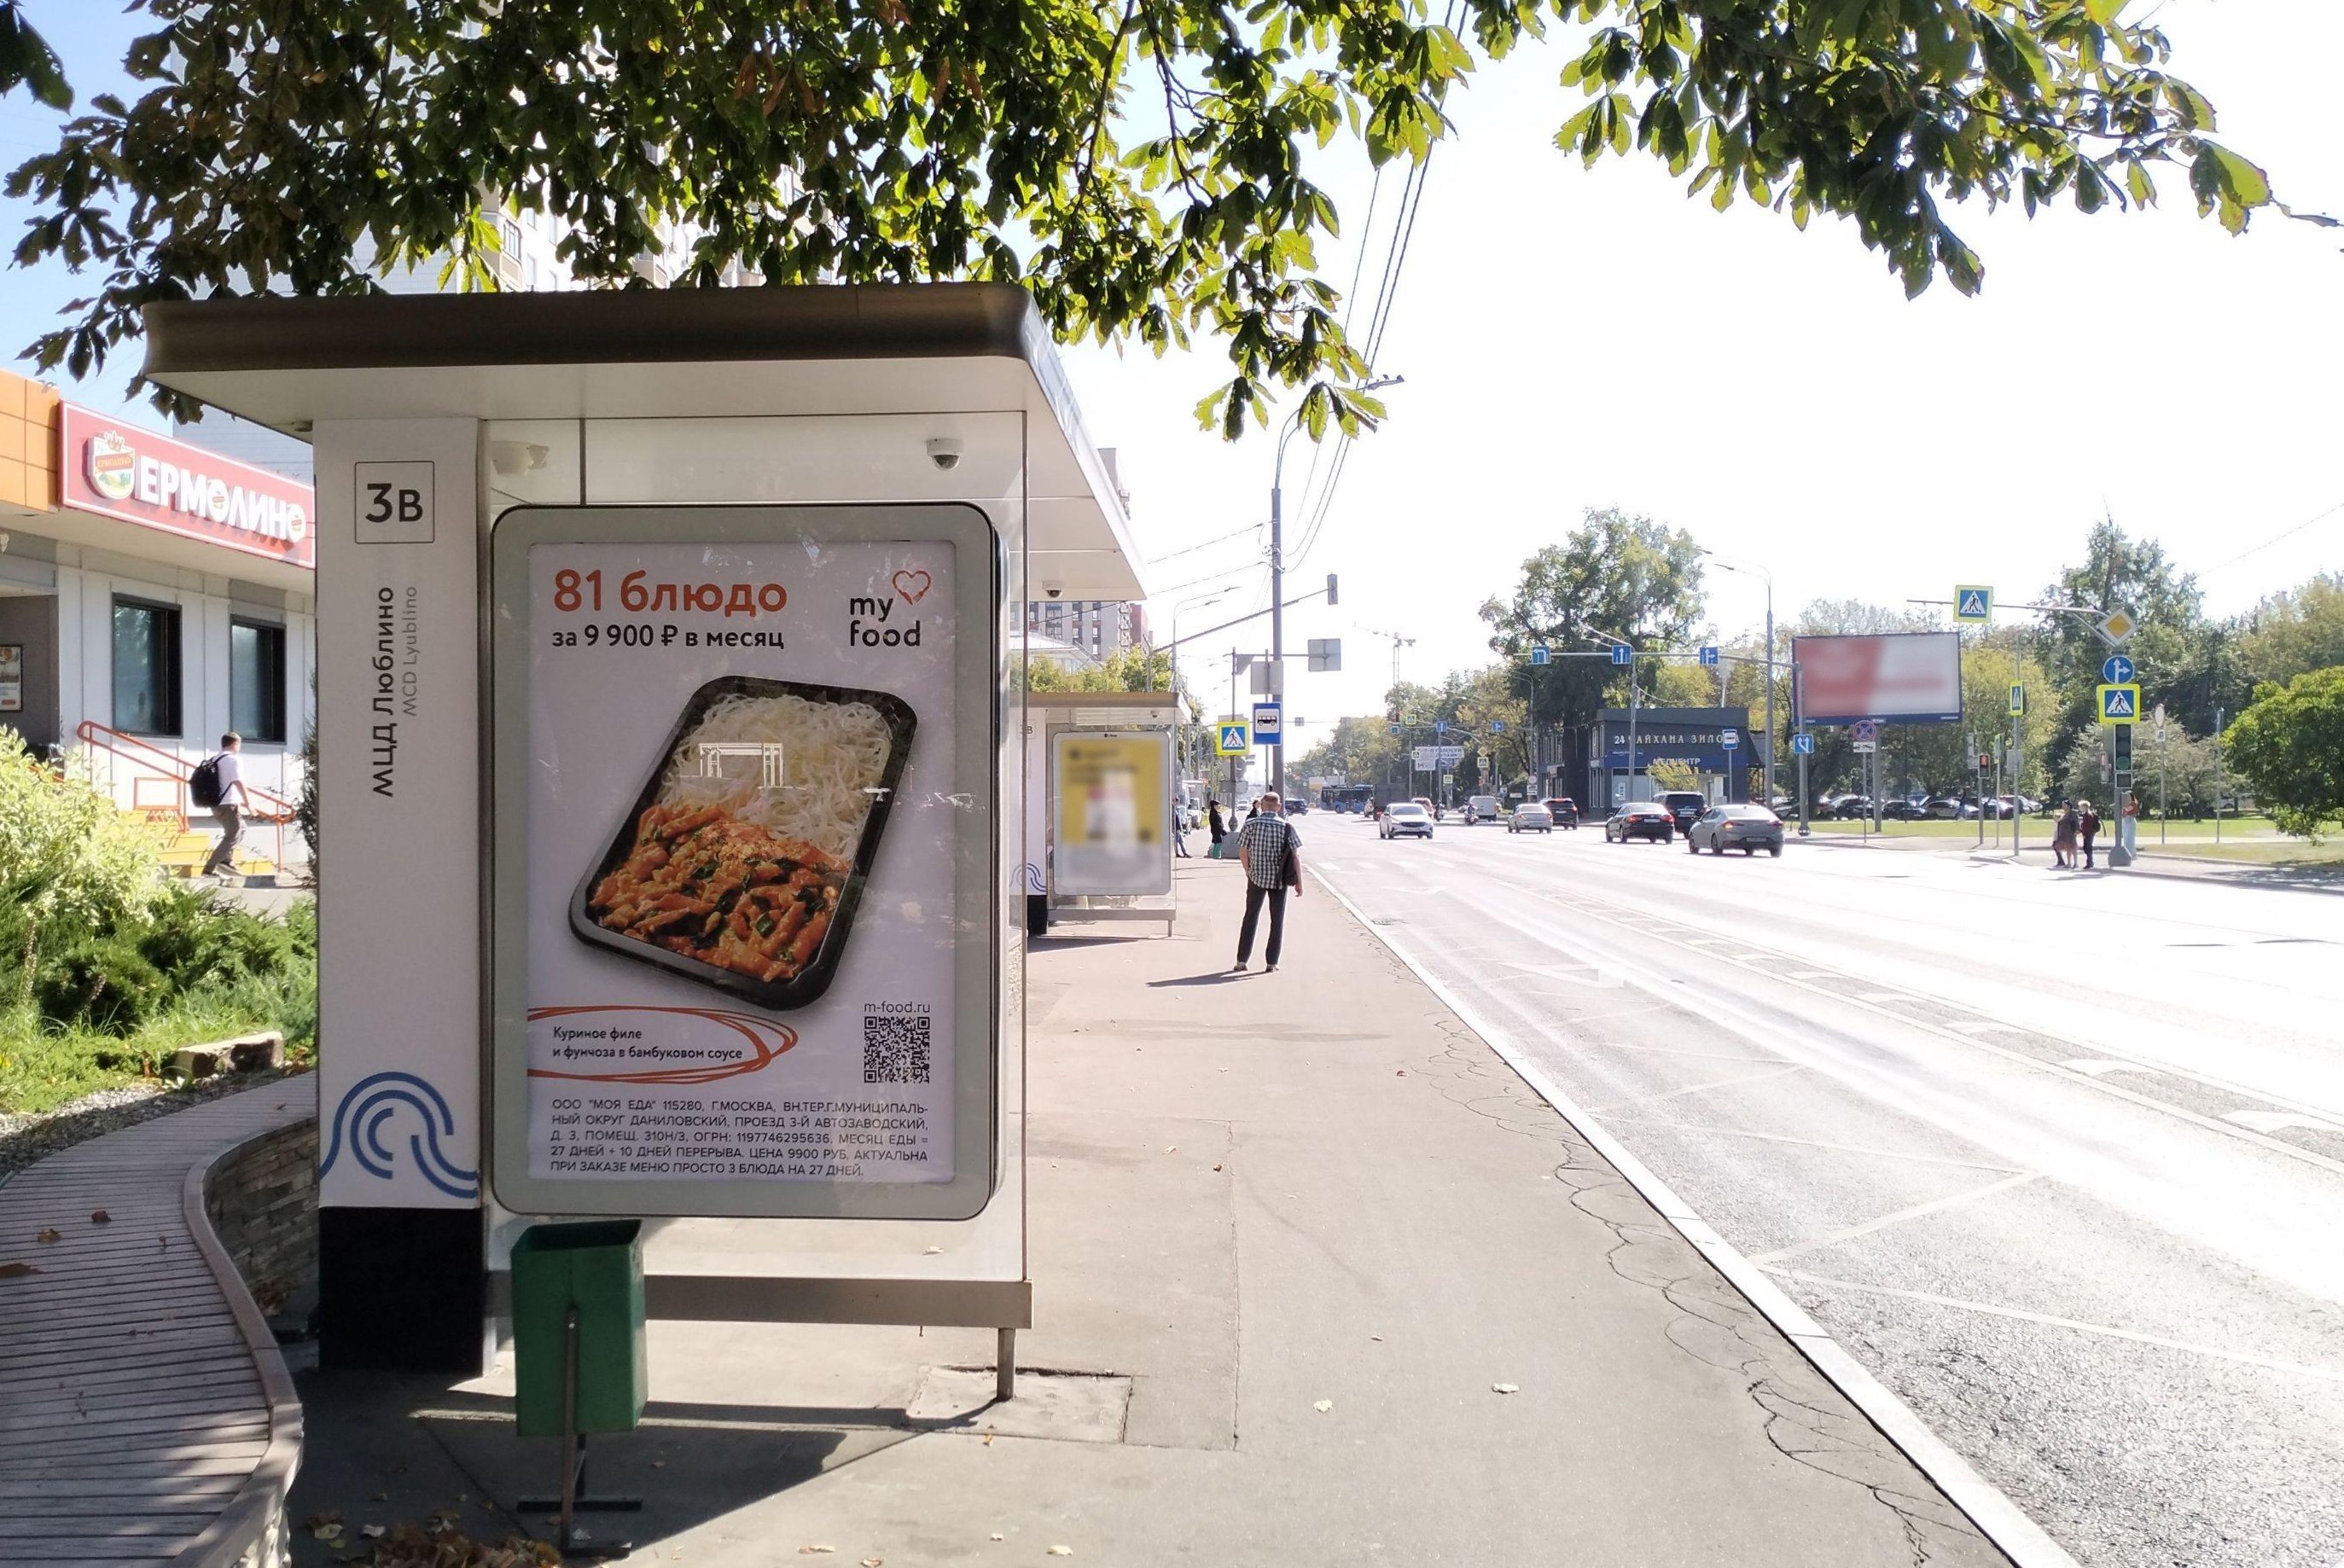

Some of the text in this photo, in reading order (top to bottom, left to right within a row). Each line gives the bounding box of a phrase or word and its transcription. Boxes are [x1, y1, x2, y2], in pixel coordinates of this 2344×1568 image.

[137, 456, 306, 543] ЕРМОЛИНО
[555, 569, 787, 618] 81 блюдо
[849, 597, 893, 623] my
[552, 632, 577, 647] за
[585, 624, 599, 646] 9
[607, 624, 654, 647] 900
[686, 632, 698, 647] в
[707, 632, 784, 649] месяц
[850, 619, 922, 647] food
[402, 586, 421, 717] MCD Lyublino
[372, 587, 398, 799] МЦД Люблино
[1614, 735, 1626, 745] 24
[1628, 735, 1684, 744] АЙХАНА
[864, 1000, 931, 1013] m-food.ru
[553, 1025, 643, 1042] Куриное филе
[552, 1044, 742, 1062] и фунчоза в бамбуковом соусе
[552, 1098, 582, 1110] ООО
[712, 1101, 776, 1113] Г.МОСКВА,
[551, 1112, 928, 1131] НЫЙ ОКРУГ ДАНИЛОВСКИЙ, ПРОЕЗД 3-Й АВТОЗАВОДСКИЙ,
[585, 1130, 639, 1142] ПОМЕЩ.
[693, 1131, 731, 1142] ОГРН:
[839, 1133, 883, 1146] МЕСЯЦ
[888, 1134, 916, 1147] ЕДЫ
[550, 1145, 566, 1156] 27
[568, 1144, 604, 1158] ДНЕЙ
[619, 1146, 633, 1157] 10
[636, 1144, 672, 1159] ДНЕЙ
[676, 1147, 745, 1159] ПЕРЕРЫВА.
[749, 1147, 784, 1159] ЦЕНА
[788, 1147, 819, 1159] 9900
[853, 1149, 928, 1162] АКТУАЛЬНА
[550, 1160, 864, 1177] ПРИ ЗАКАЗЕ МЕНЮ ПРОСТО 3 БЛЮДА НА 27 ДНЕЙ.
